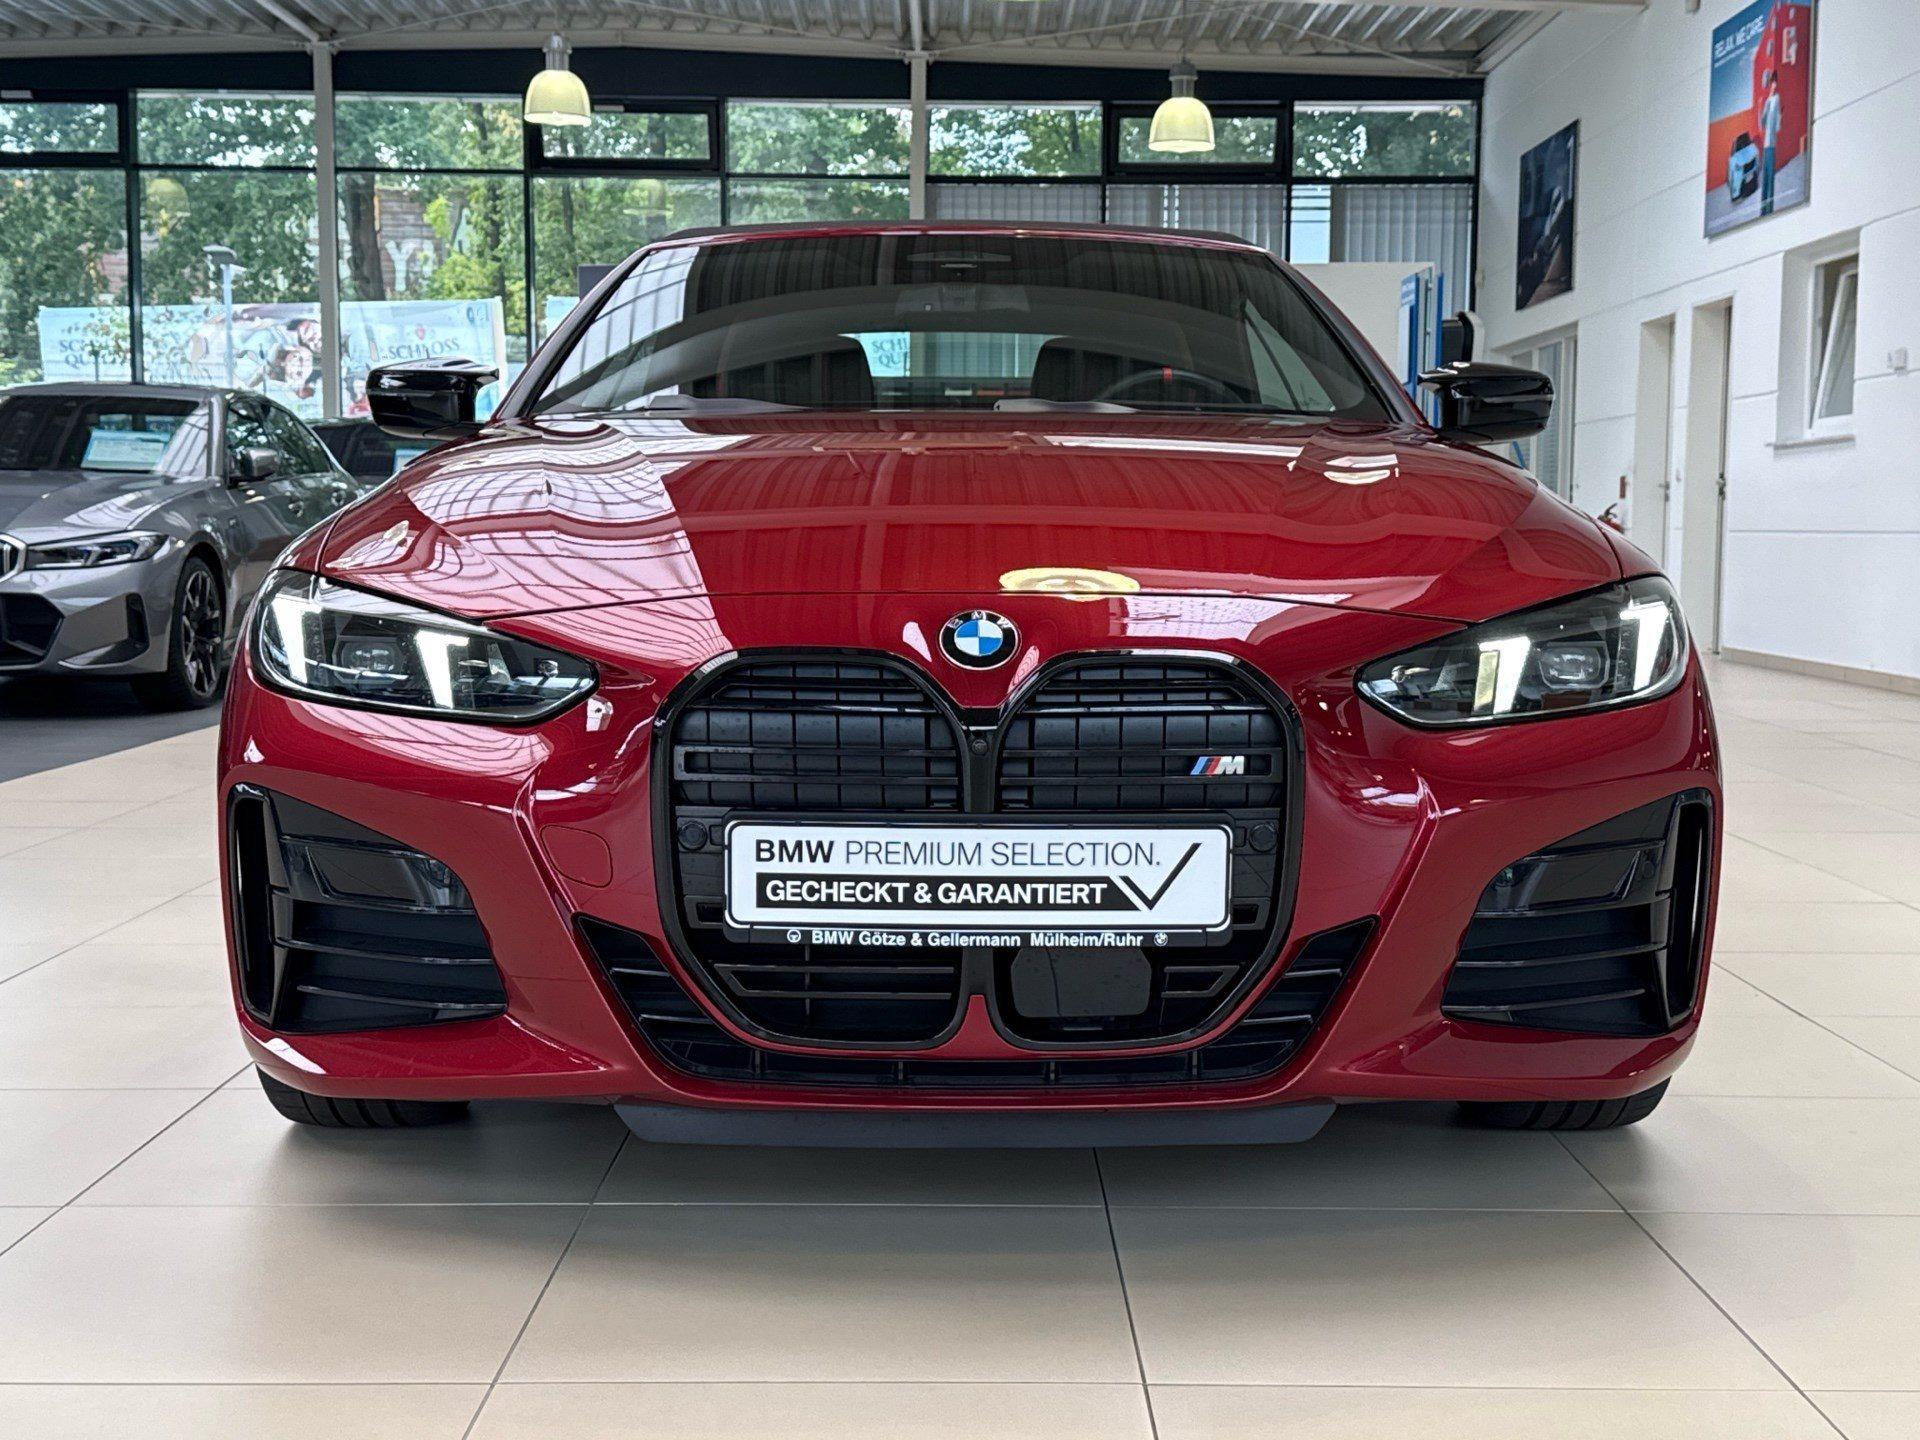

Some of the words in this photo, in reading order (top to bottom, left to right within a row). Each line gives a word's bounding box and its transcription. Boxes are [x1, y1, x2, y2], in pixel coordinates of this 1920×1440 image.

[755, 838, 835, 864] BMW
[845, 840, 982, 867] PREMIUM
[990, 841, 1161, 867] SELECTION.
[765, 879, 910, 903] GECHECKT
[913, 882, 933, 904] &
[937, 882, 1108, 905] GARANTIERT
[811, 929, 855, 946] BMW
[858, 931, 906, 948] Götze
[910, 933, 924, 947] &
[927, 932, 1021, 948] Gellermann
[1030, 932, 1144, 948] Mülheim/Ruhr
